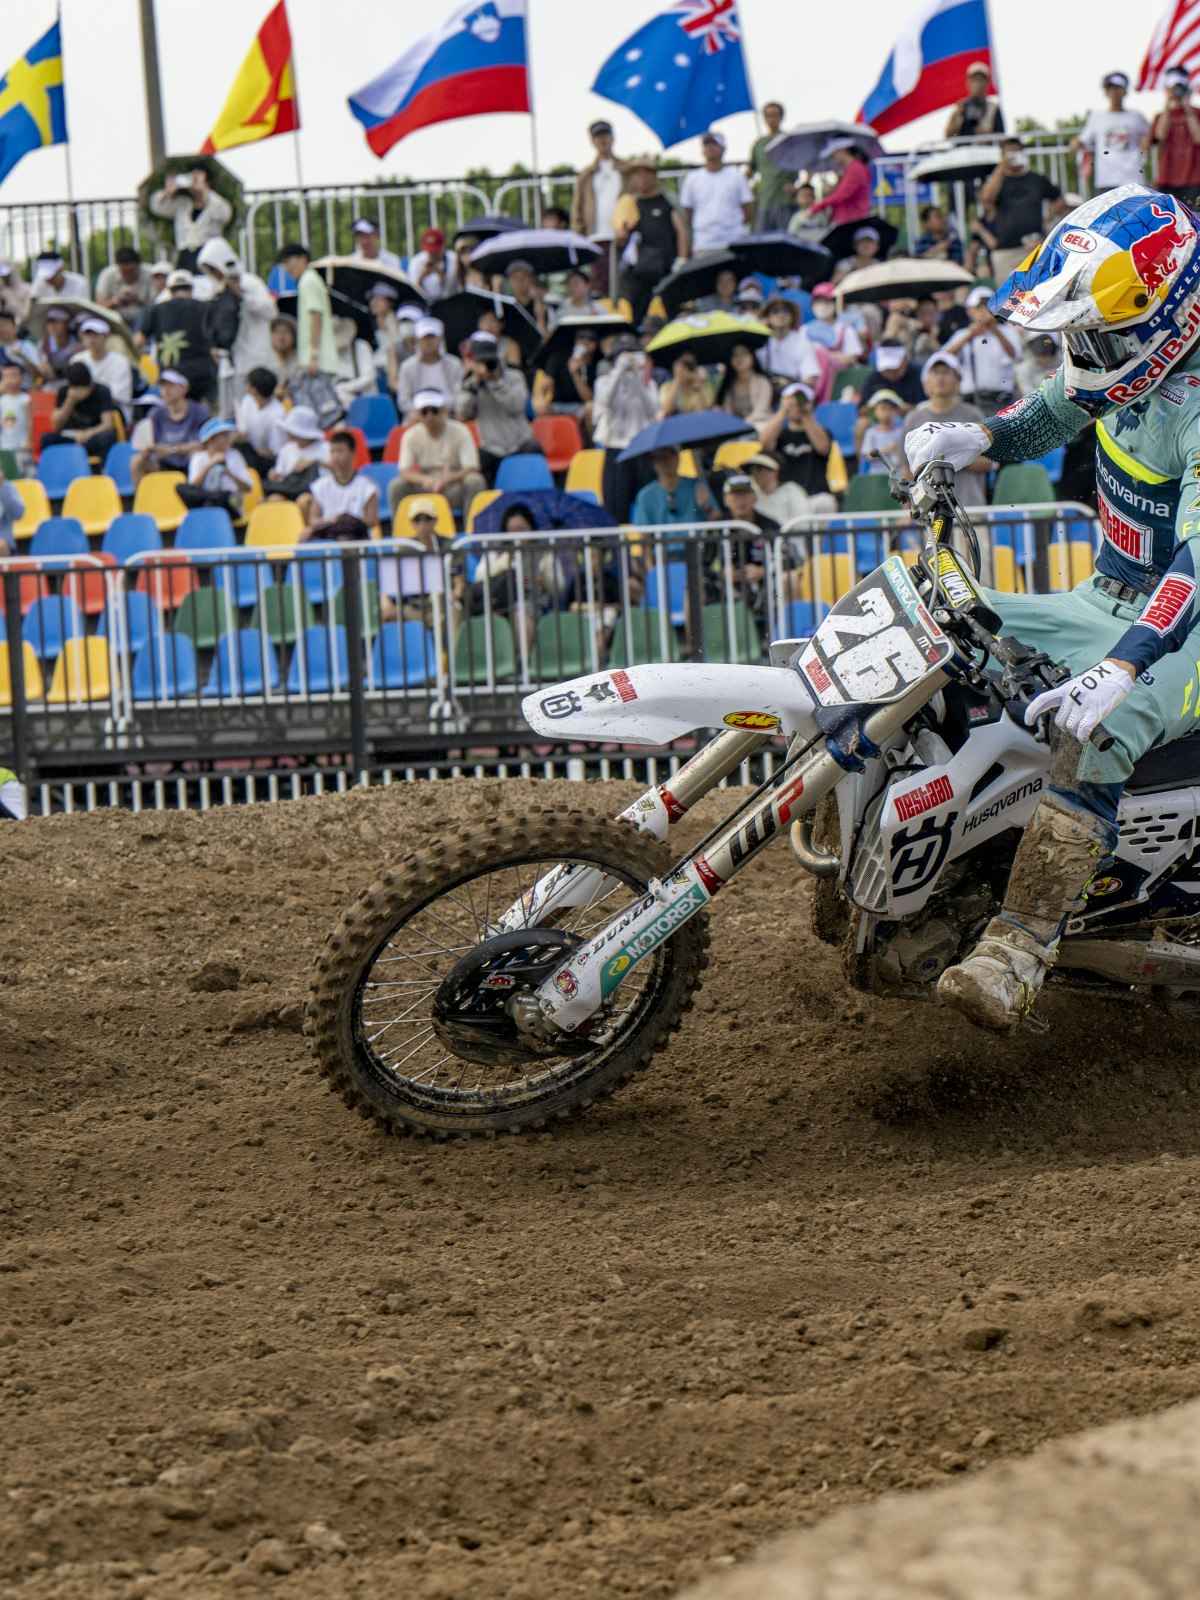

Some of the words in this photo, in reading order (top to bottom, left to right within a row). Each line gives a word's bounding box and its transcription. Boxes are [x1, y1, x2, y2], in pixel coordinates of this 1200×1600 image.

[1063, 232, 1091, 251] BELL
[1004, 300, 1016, 312] Red
[1016, 305, 1037, 318] Bull
[1105, 355, 1166, 405] Red
[1096, 444, 1170, 518] usqvarna
[889, 568, 917, 609] MOTOREX
[815, 587, 928, 701] 26
[1069, 665, 1112, 707] FOX
[726, 714, 782, 727] FMF
[893, 774, 954, 823] nestaan
[961, 777, 1043, 837] Husqvarna
[592, 893, 657, 955] DUNLO
[626, 890, 701, 959] MOTOREX
